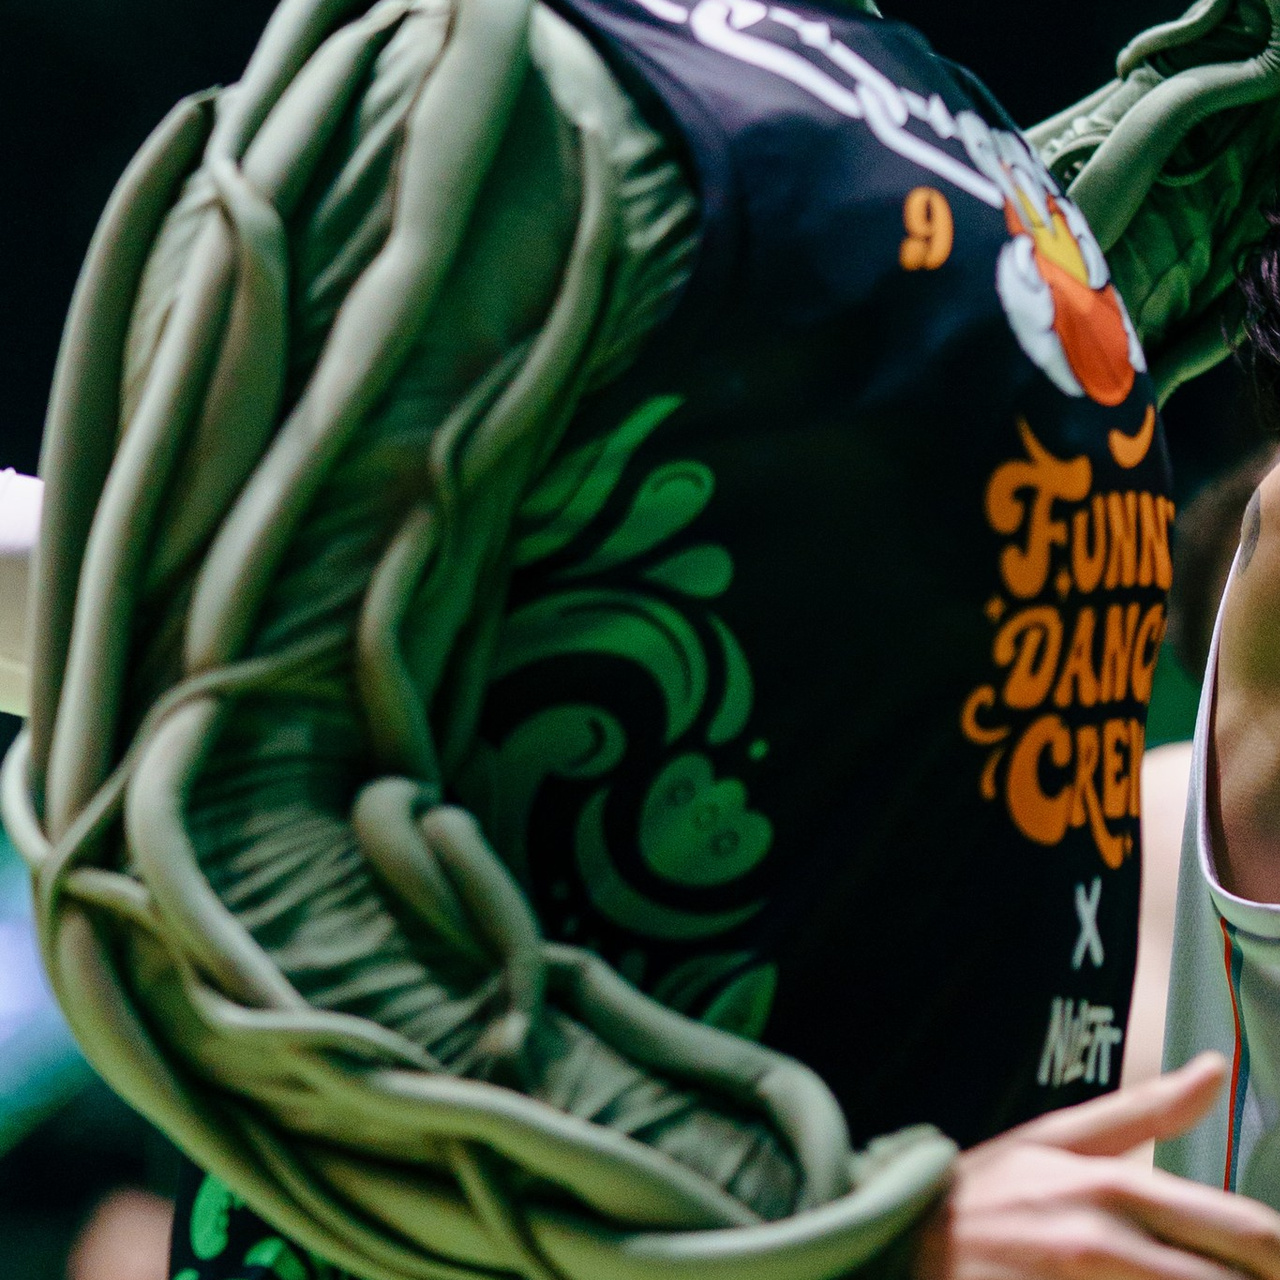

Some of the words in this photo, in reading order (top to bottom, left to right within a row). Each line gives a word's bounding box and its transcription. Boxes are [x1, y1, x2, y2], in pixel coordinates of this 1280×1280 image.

[900, 187, 953, 270] 9
[984, 414, 1175, 598] FUNN
[1071, 875, 1105, 969] X
